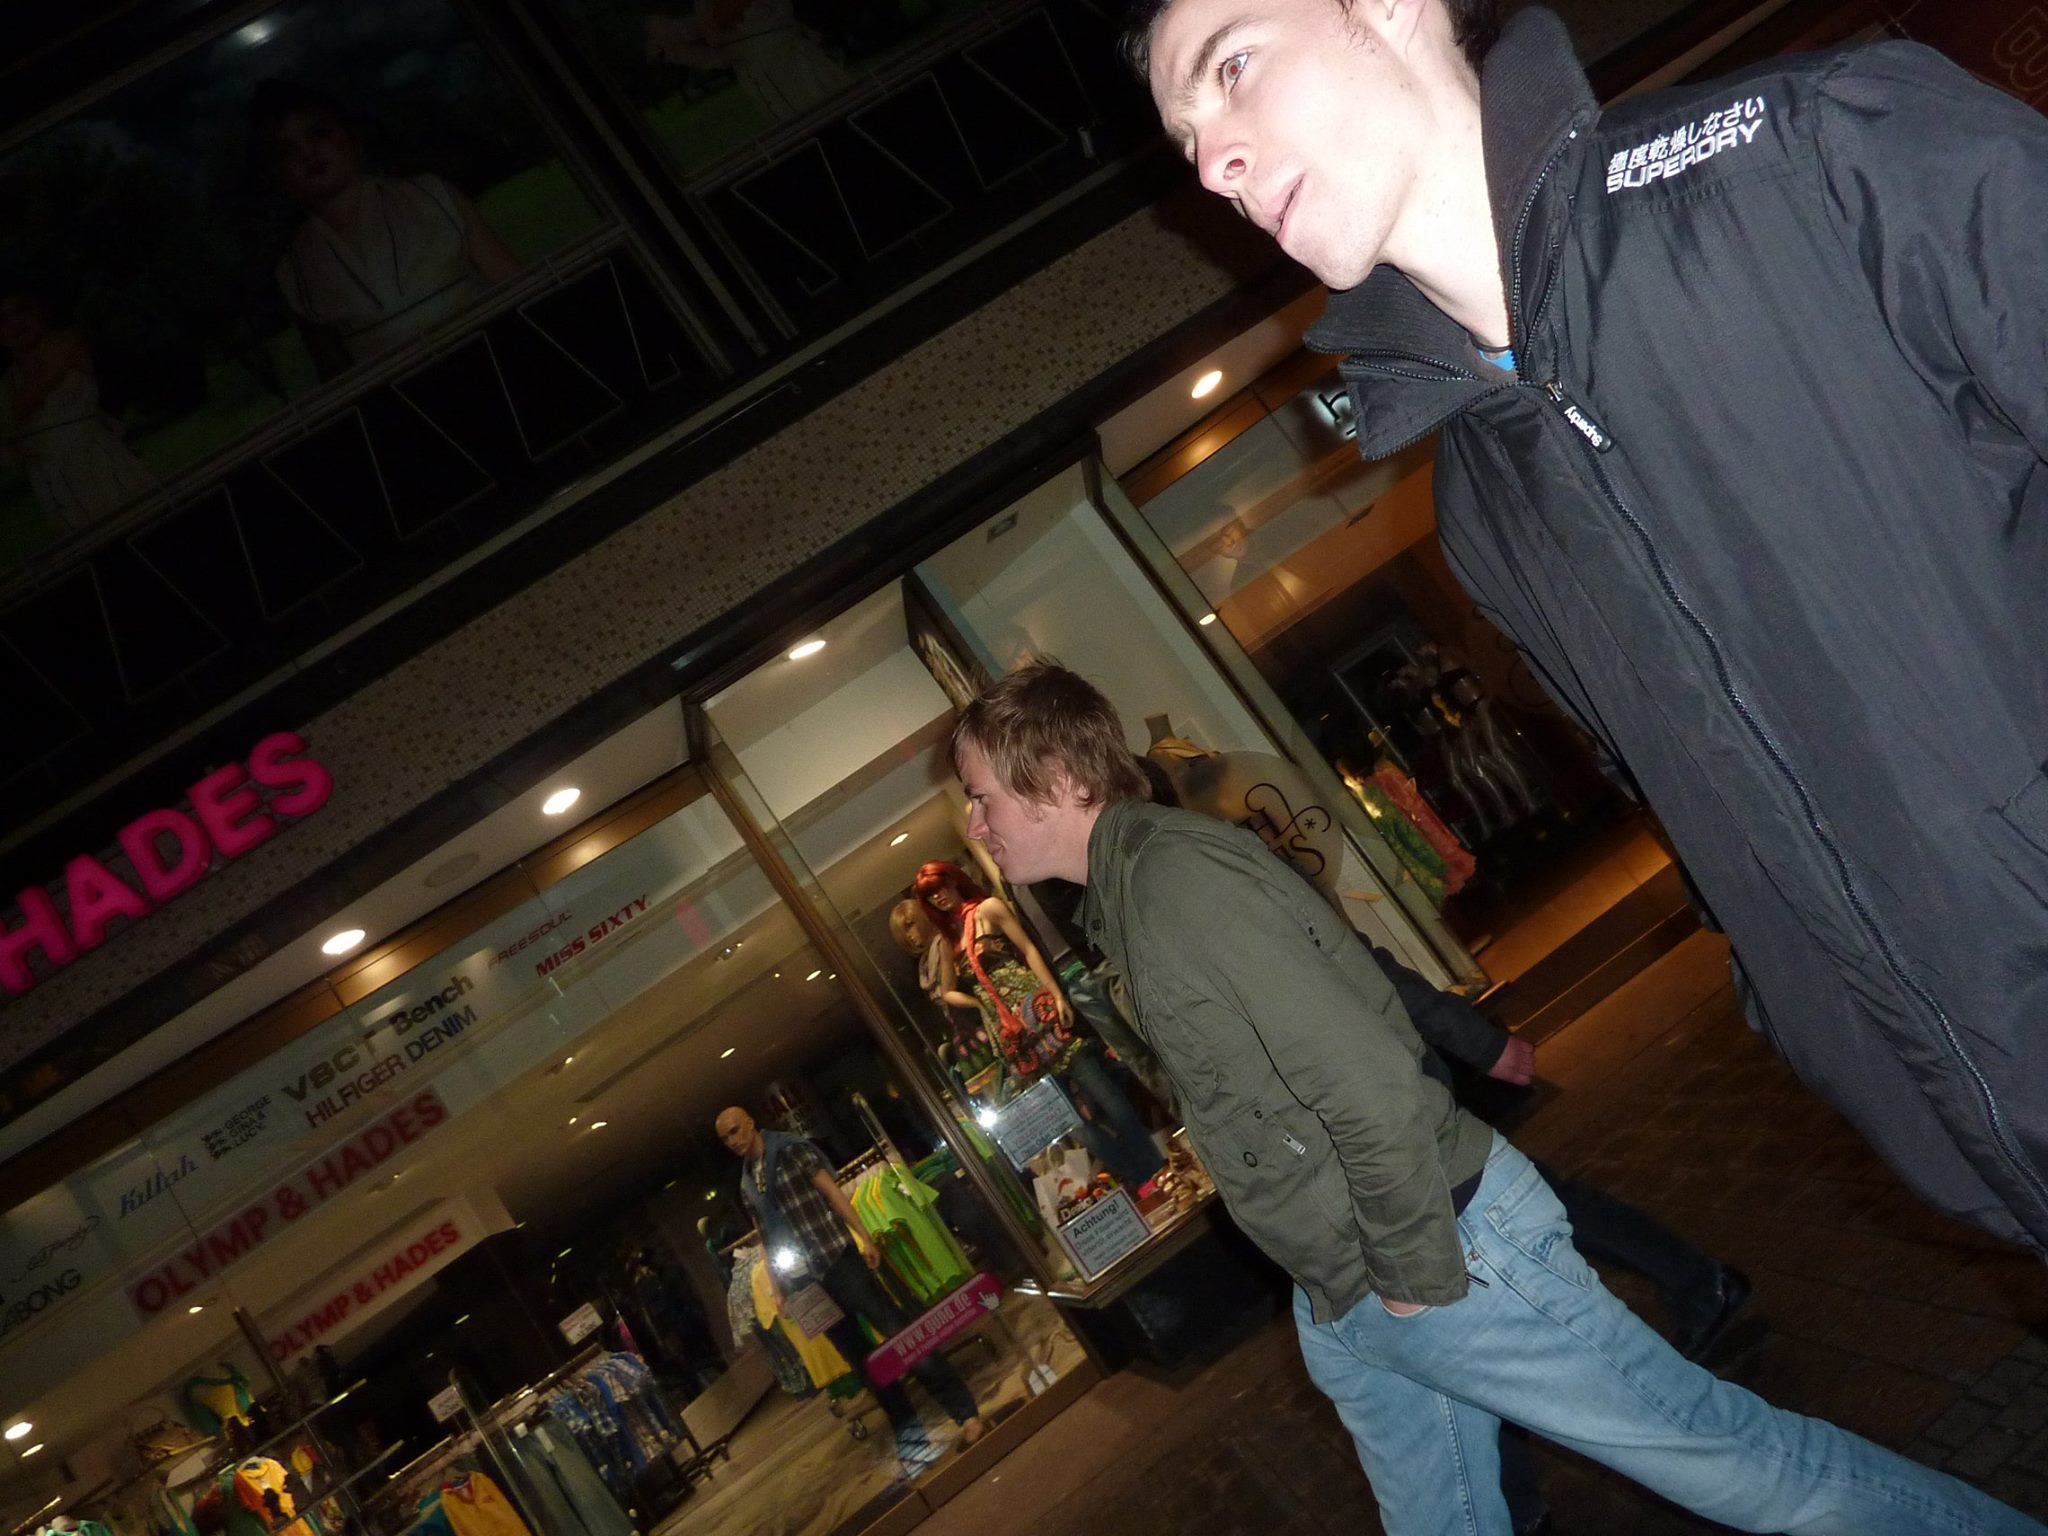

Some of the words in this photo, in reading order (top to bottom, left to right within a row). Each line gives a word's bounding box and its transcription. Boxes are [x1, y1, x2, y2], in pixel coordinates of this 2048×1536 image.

[1606, 119, 1763, 194] SUPERDRY
[0, 731, 334, 995] HADES
[488, 909, 573, 971] FREESOUL
[535, 936, 587, 977] MISS
[588, 894, 648, 944] SIXTY
[389, 975, 474, 1036] Bench
[304, 1054, 407, 1129] HILFIGER
[404, 1004, 478, 1063] DENIM
[224, 1094, 272, 1130] GEORGE
[135, 1207, 269, 1313] OLYMP
[275, 1186, 309, 1221] &
[305, 1093, 445, 1199] HADES
[1073, 1199, 1120, 1238] Achtung!
[269, 1294, 350, 1363] OLYMP
[352, 1282, 377, 1306] &
[372, 1221, 461, 1293] HADES
